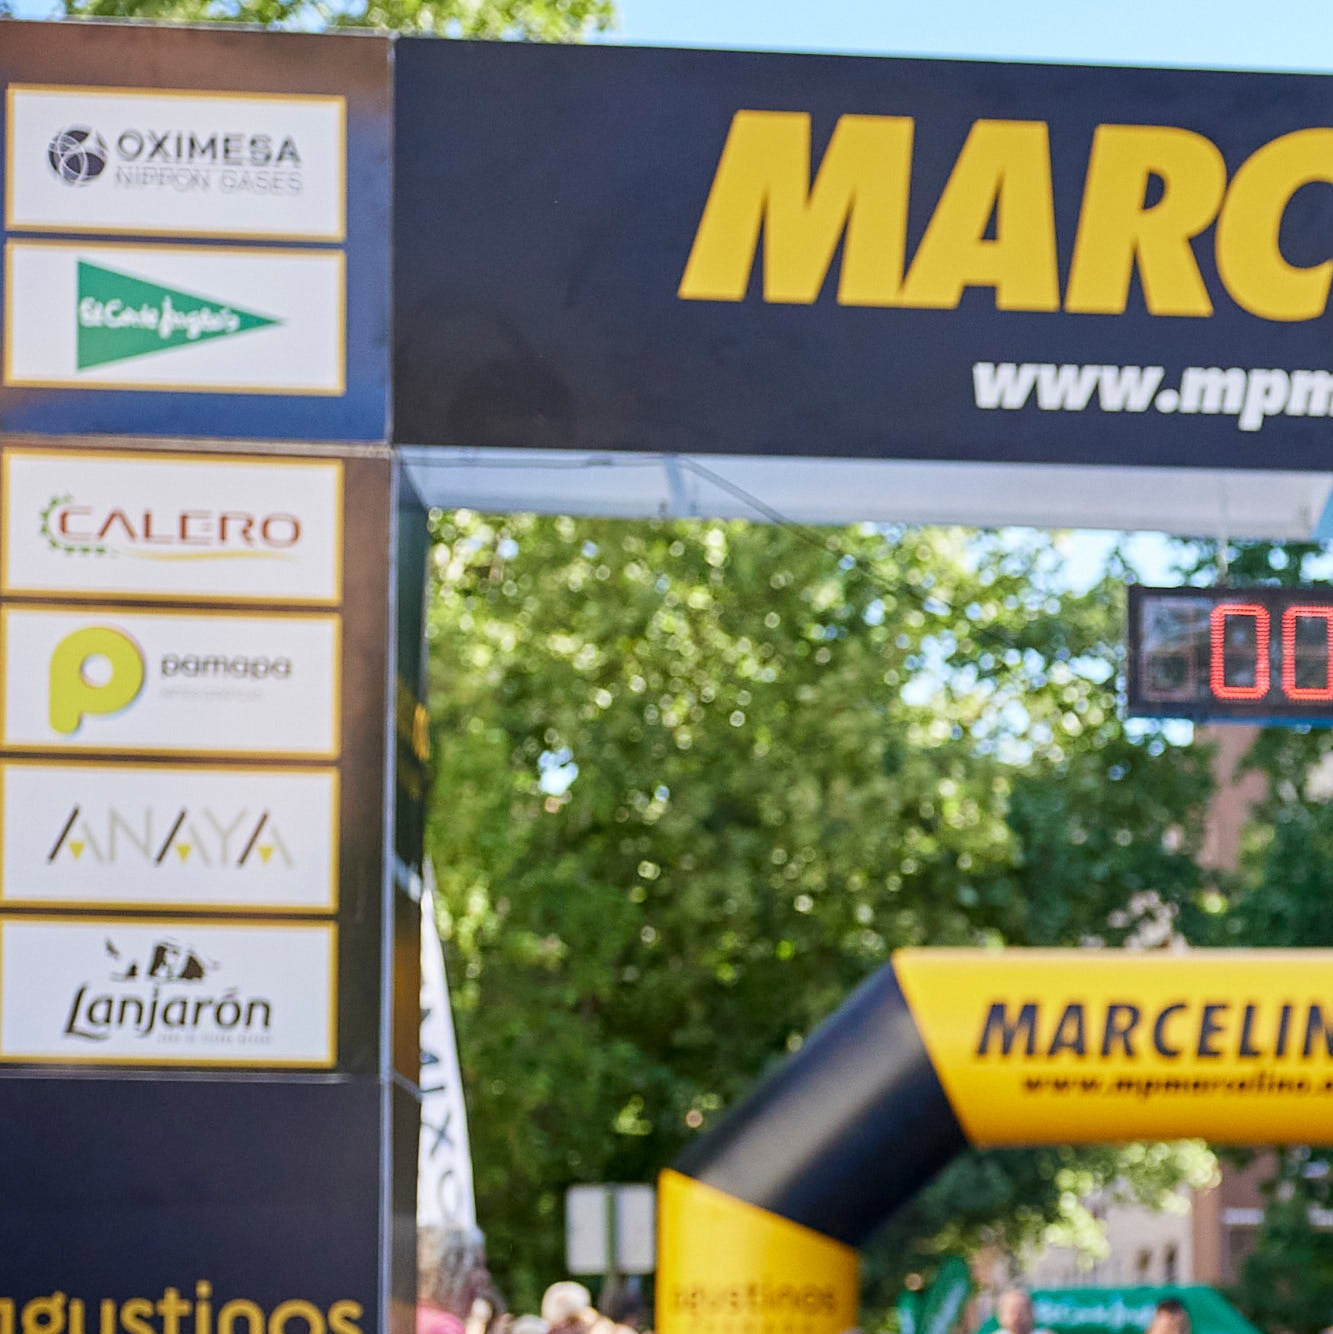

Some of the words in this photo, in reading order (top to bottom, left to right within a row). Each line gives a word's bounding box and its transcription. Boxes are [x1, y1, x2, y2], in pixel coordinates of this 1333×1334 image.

[116, 129, 302, 168] OXIMESA
[58, 506, 301, 548] CALERO
[48, 803, 294, 868] ANAYA
[64, 982, 272, 1041] Lanjarón
